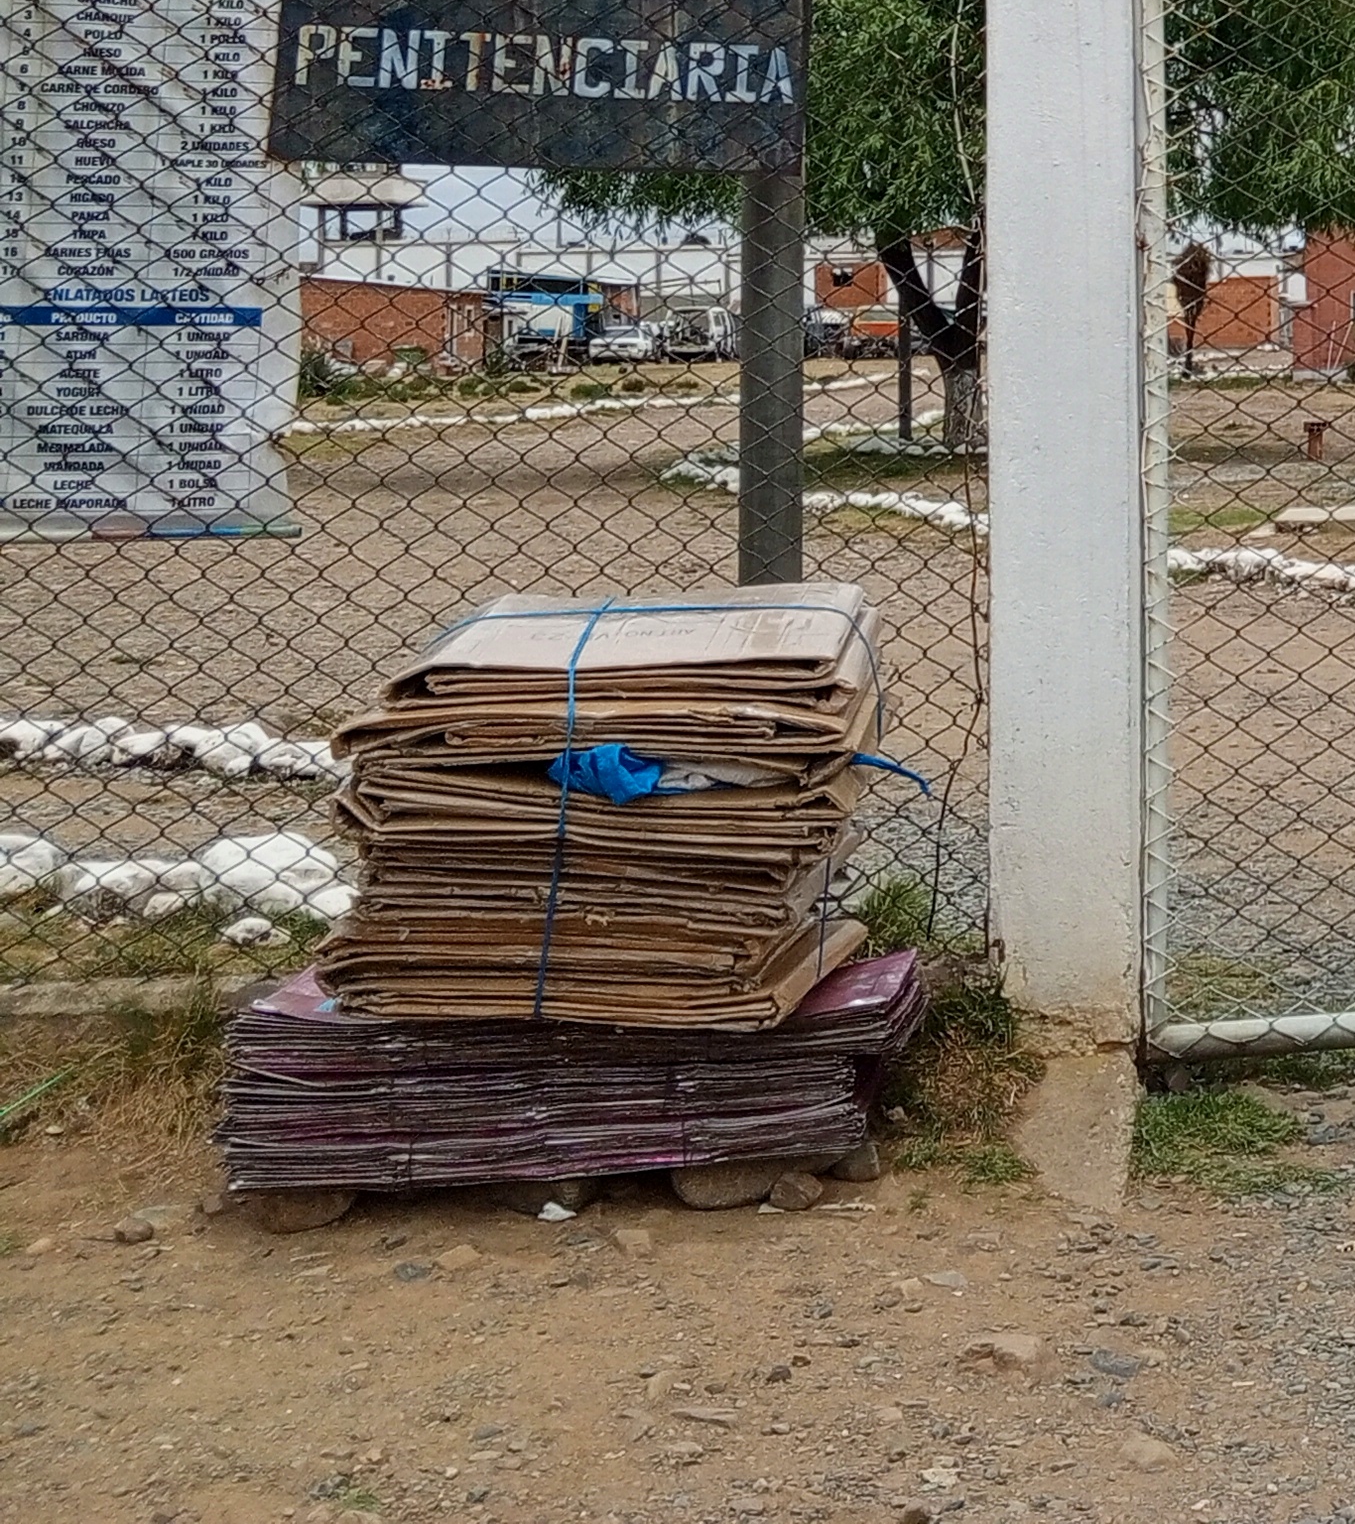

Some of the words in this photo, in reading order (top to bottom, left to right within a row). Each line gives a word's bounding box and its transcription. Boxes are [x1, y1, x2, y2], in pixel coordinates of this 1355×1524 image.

[294, 24, 794, 104] PENITENCIARIA
[40, 83, 81, 94] CARNE
[205, 160, 218, 169] 30
[205, 178, 232, 187] KILO
[201, 231, 228, 241] KILO
[45, 288, 135, 302] ENLATADOS
[53, 480, 93, 490] LECHE
[13, 498, 52, 509] LECHE
